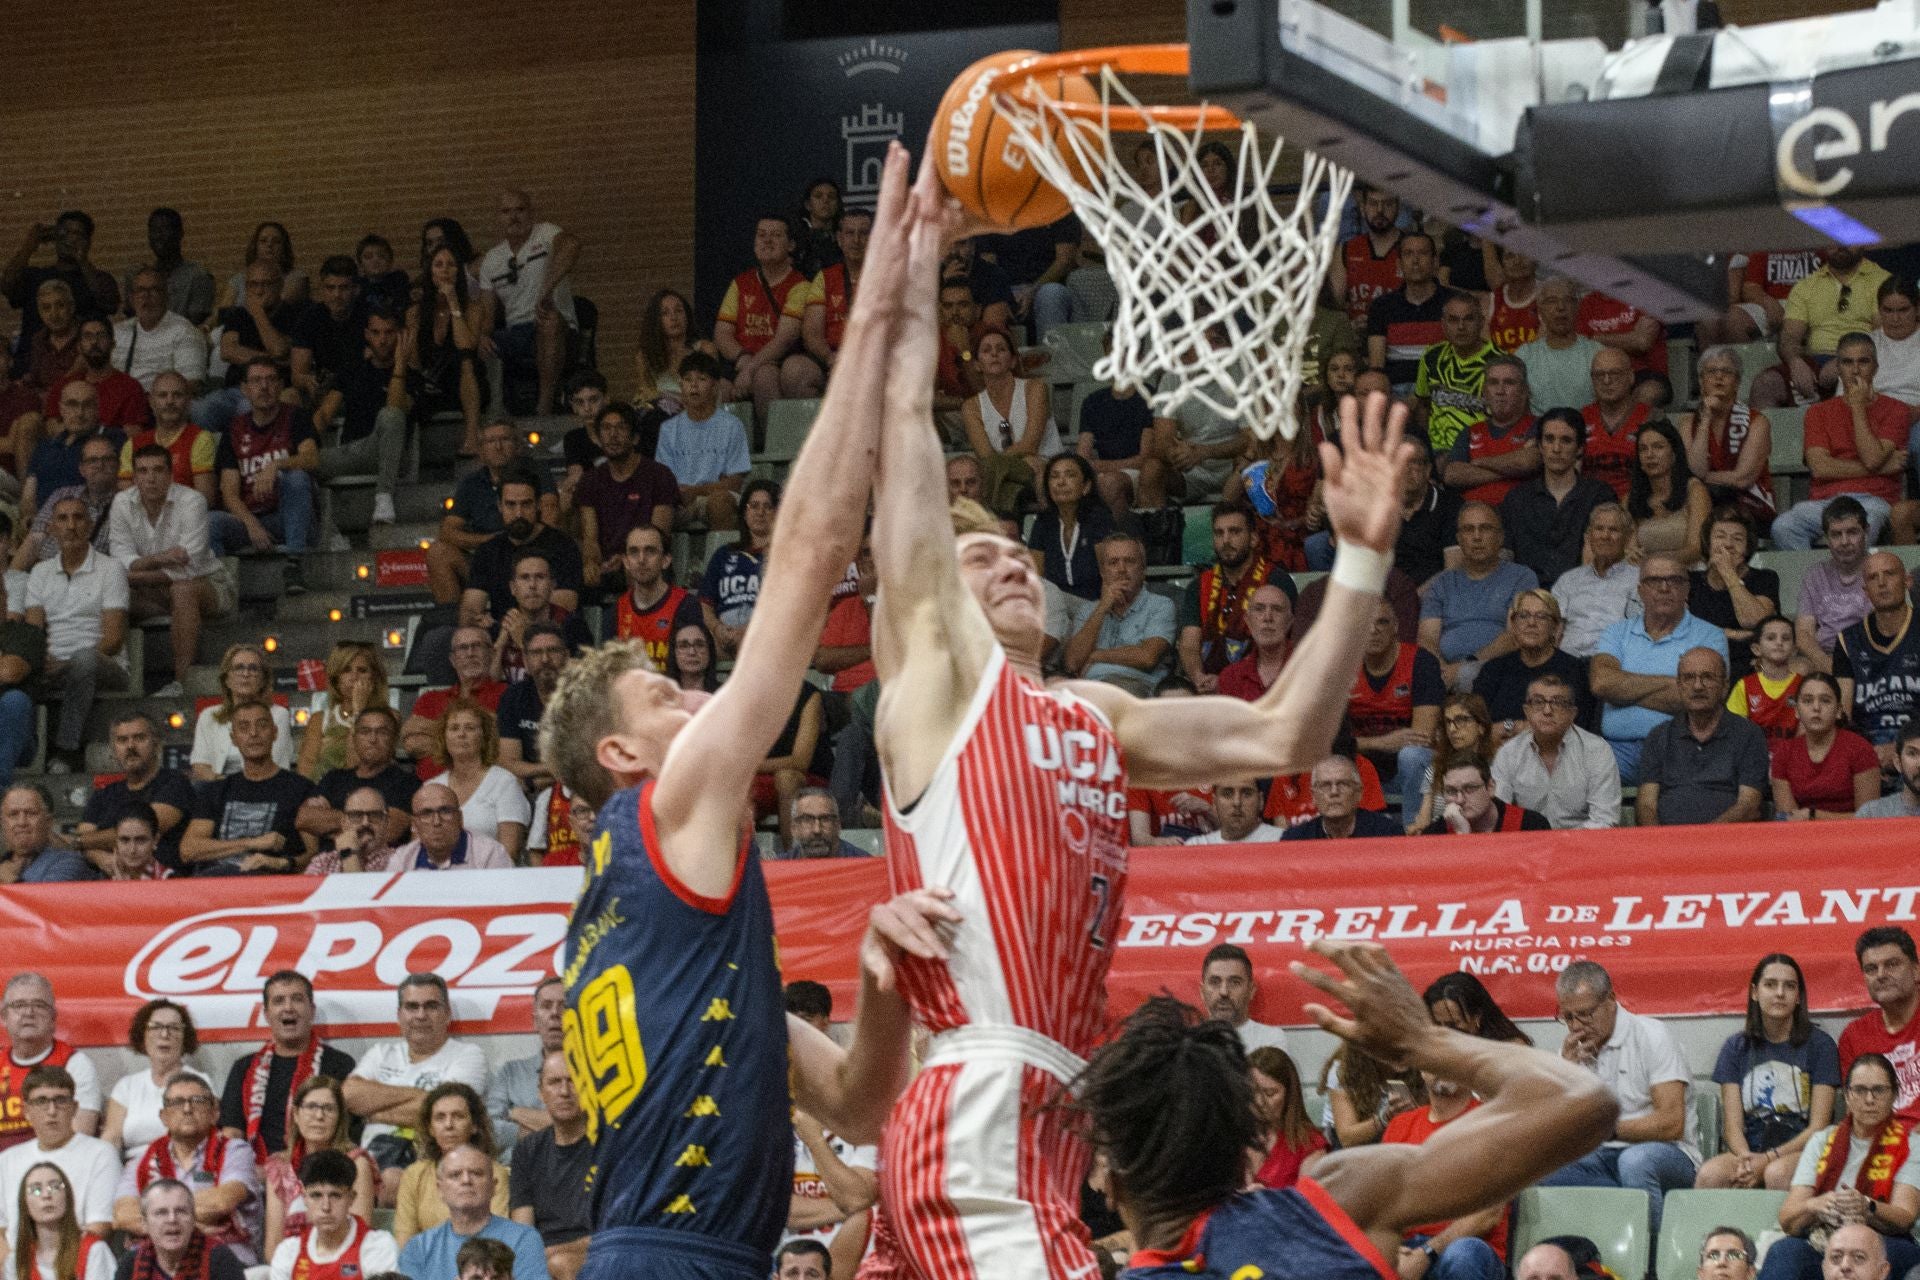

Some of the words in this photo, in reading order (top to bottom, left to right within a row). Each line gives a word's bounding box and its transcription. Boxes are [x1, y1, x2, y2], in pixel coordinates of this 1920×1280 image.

[1118, 899, 1530, 948] ESTRELLA
[1545, 905, 1600, 924] DE
[1449, 935, 1562, 952] MURCIA
[1569, 935, 1633, 948] 1963
